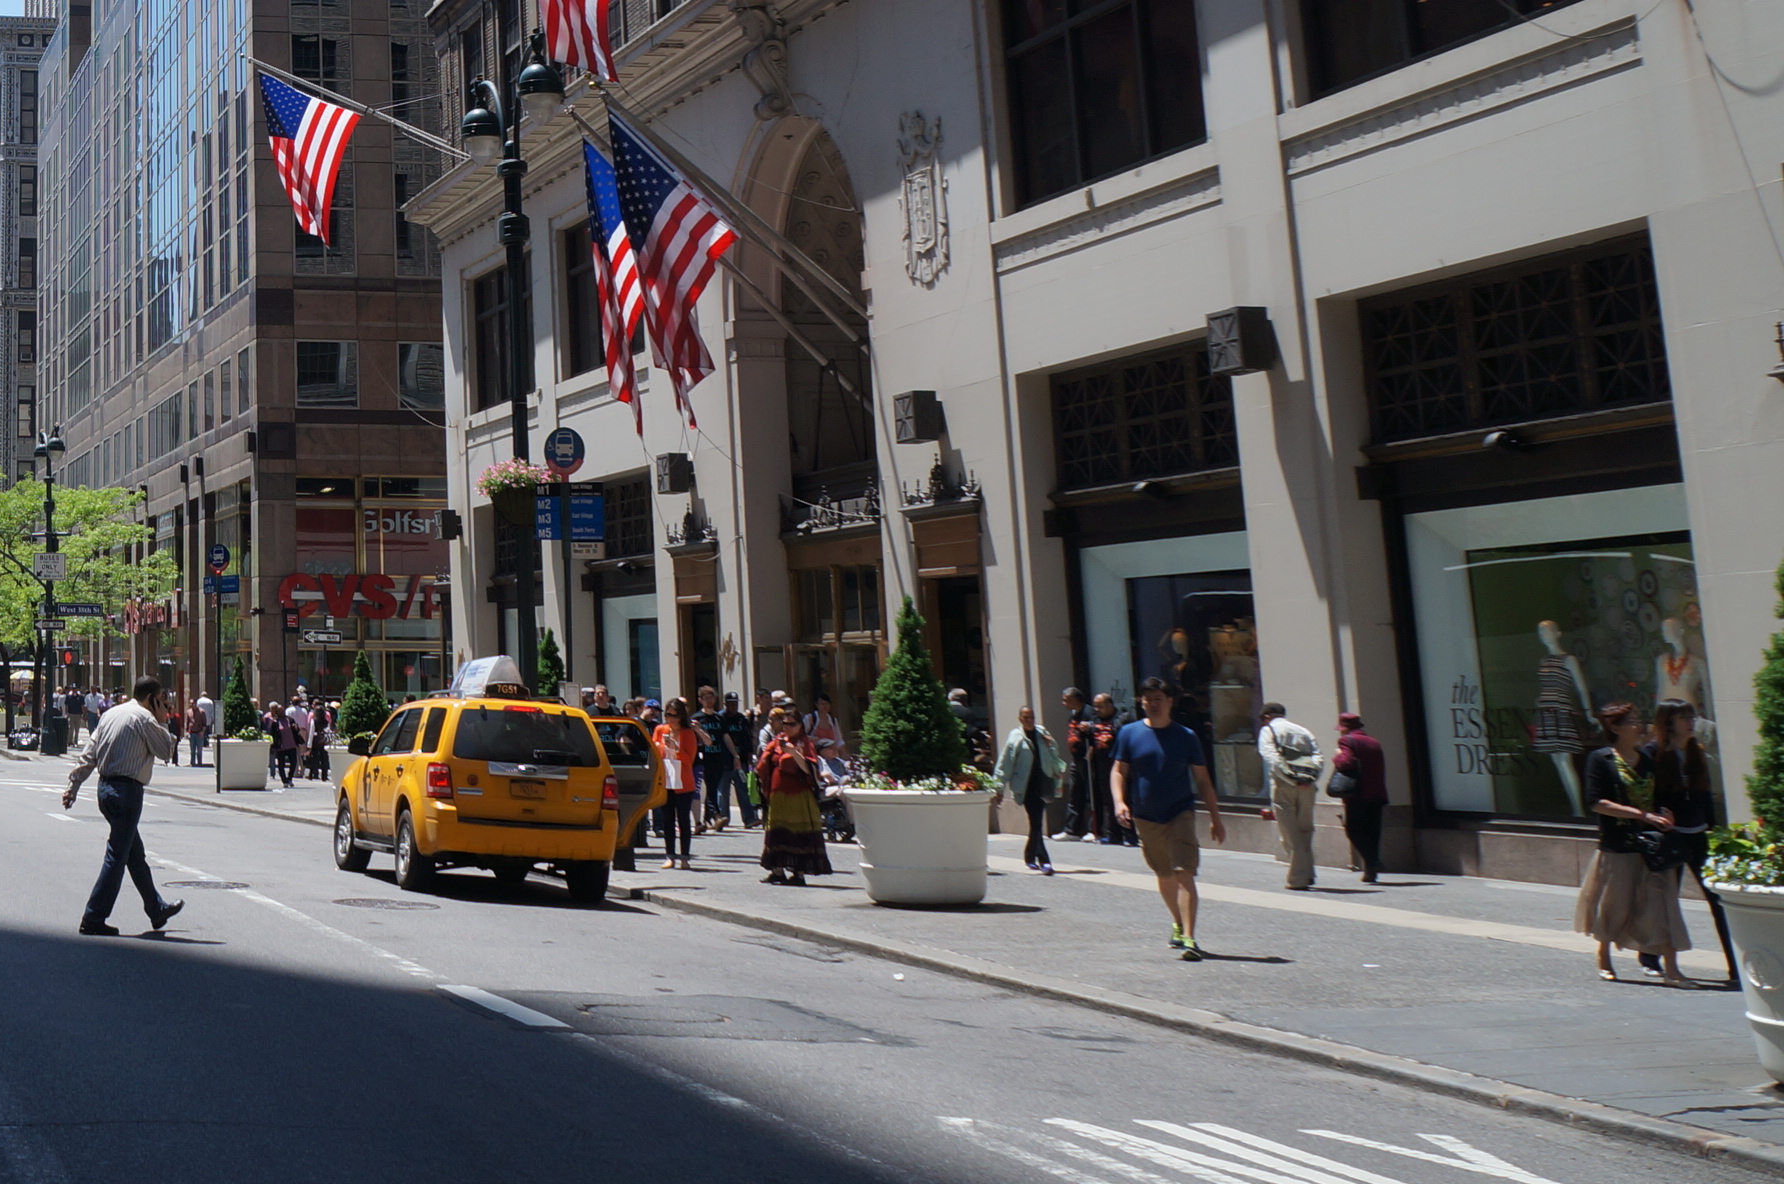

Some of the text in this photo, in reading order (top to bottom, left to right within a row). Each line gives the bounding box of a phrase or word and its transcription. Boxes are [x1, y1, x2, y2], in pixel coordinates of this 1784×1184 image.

[537, 485, 550, 495] M1
[538, 499, 552, 509] M2
[538, 514, 552, 524] M3
[539, 528, 552, 538] M5
[498, 685, 518, 695] 7G51
[1450, 674, 1480, 705] the
